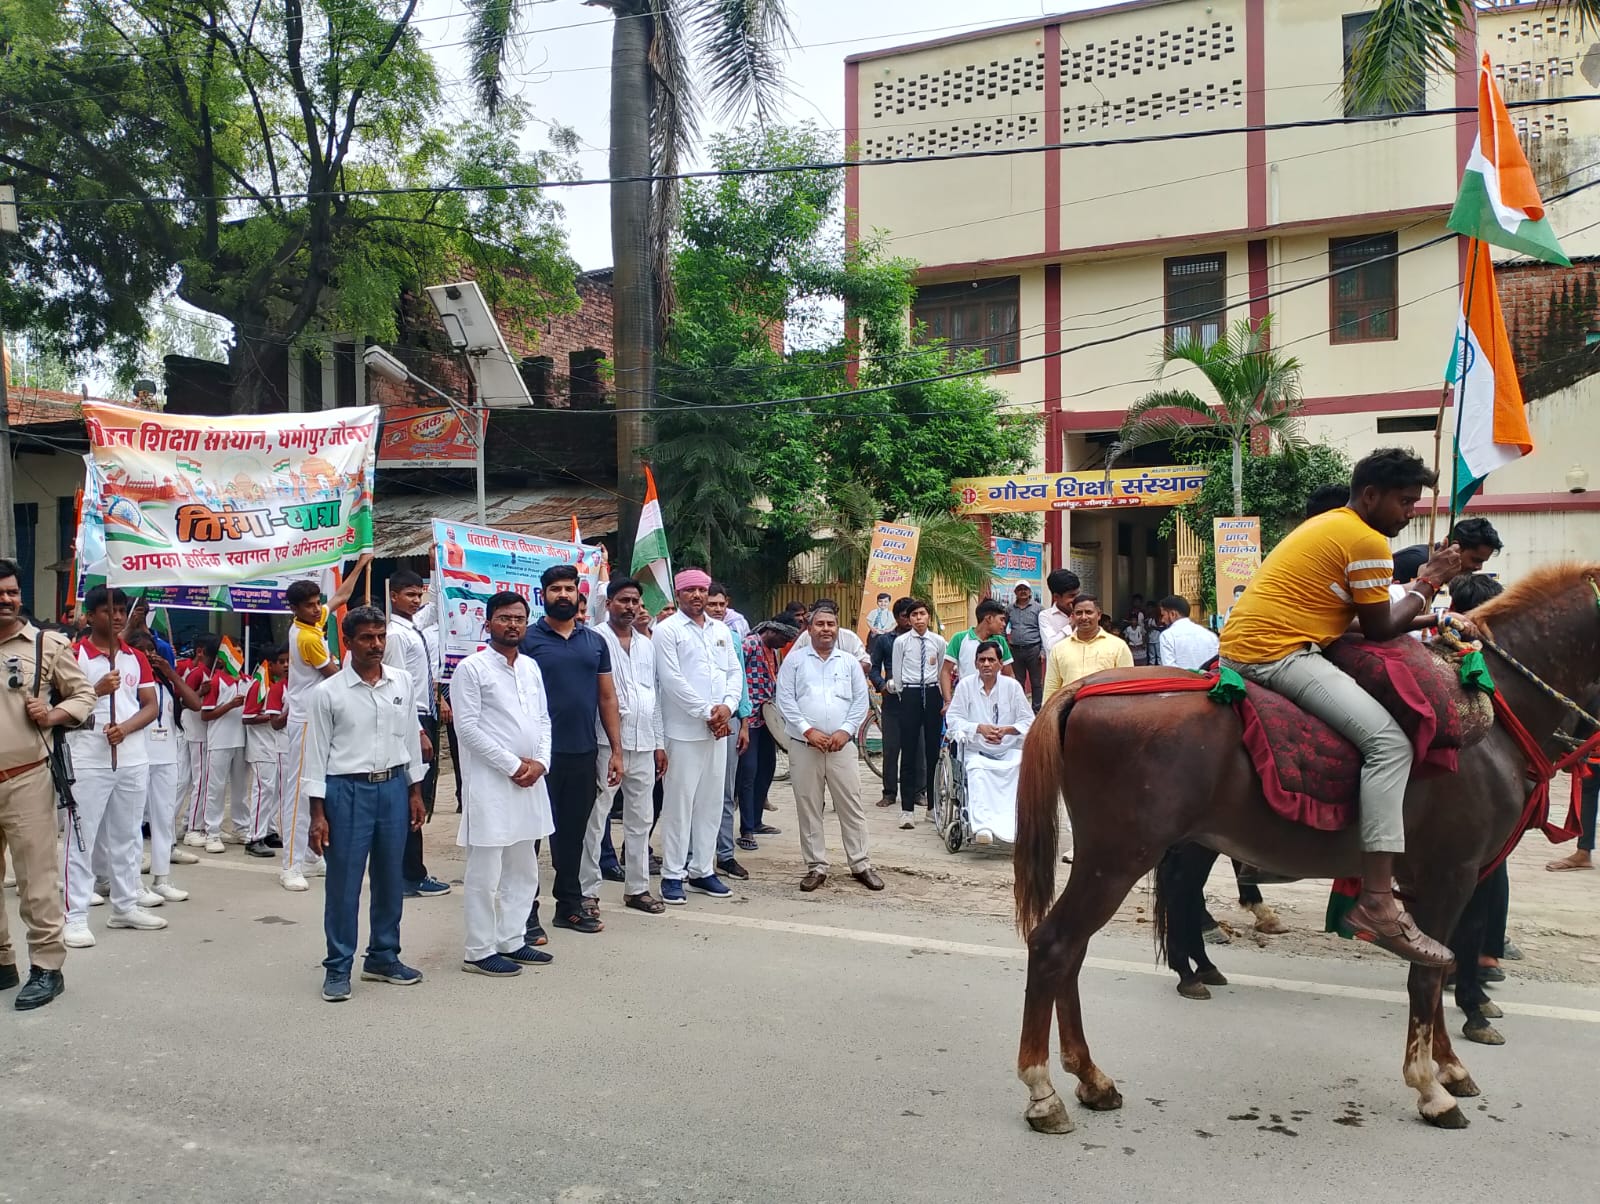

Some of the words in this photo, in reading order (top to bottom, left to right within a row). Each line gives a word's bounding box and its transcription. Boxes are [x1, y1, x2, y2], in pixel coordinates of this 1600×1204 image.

[140, 422, 199, 451] शिक्षा
[988, 480, 1049, 500] गौरव
[1055, 477, 1115, 498] शिक्षा
[1121, 472, 1207, 494] संस्थान
[122, 552, 181, 571] आपका
[182, 548, 221, 568] हार्दिक
[225, 547, 270, 566] स्वागत
[274, 541, 291, 560] एवं
[501, 538, 517, 551] राज
